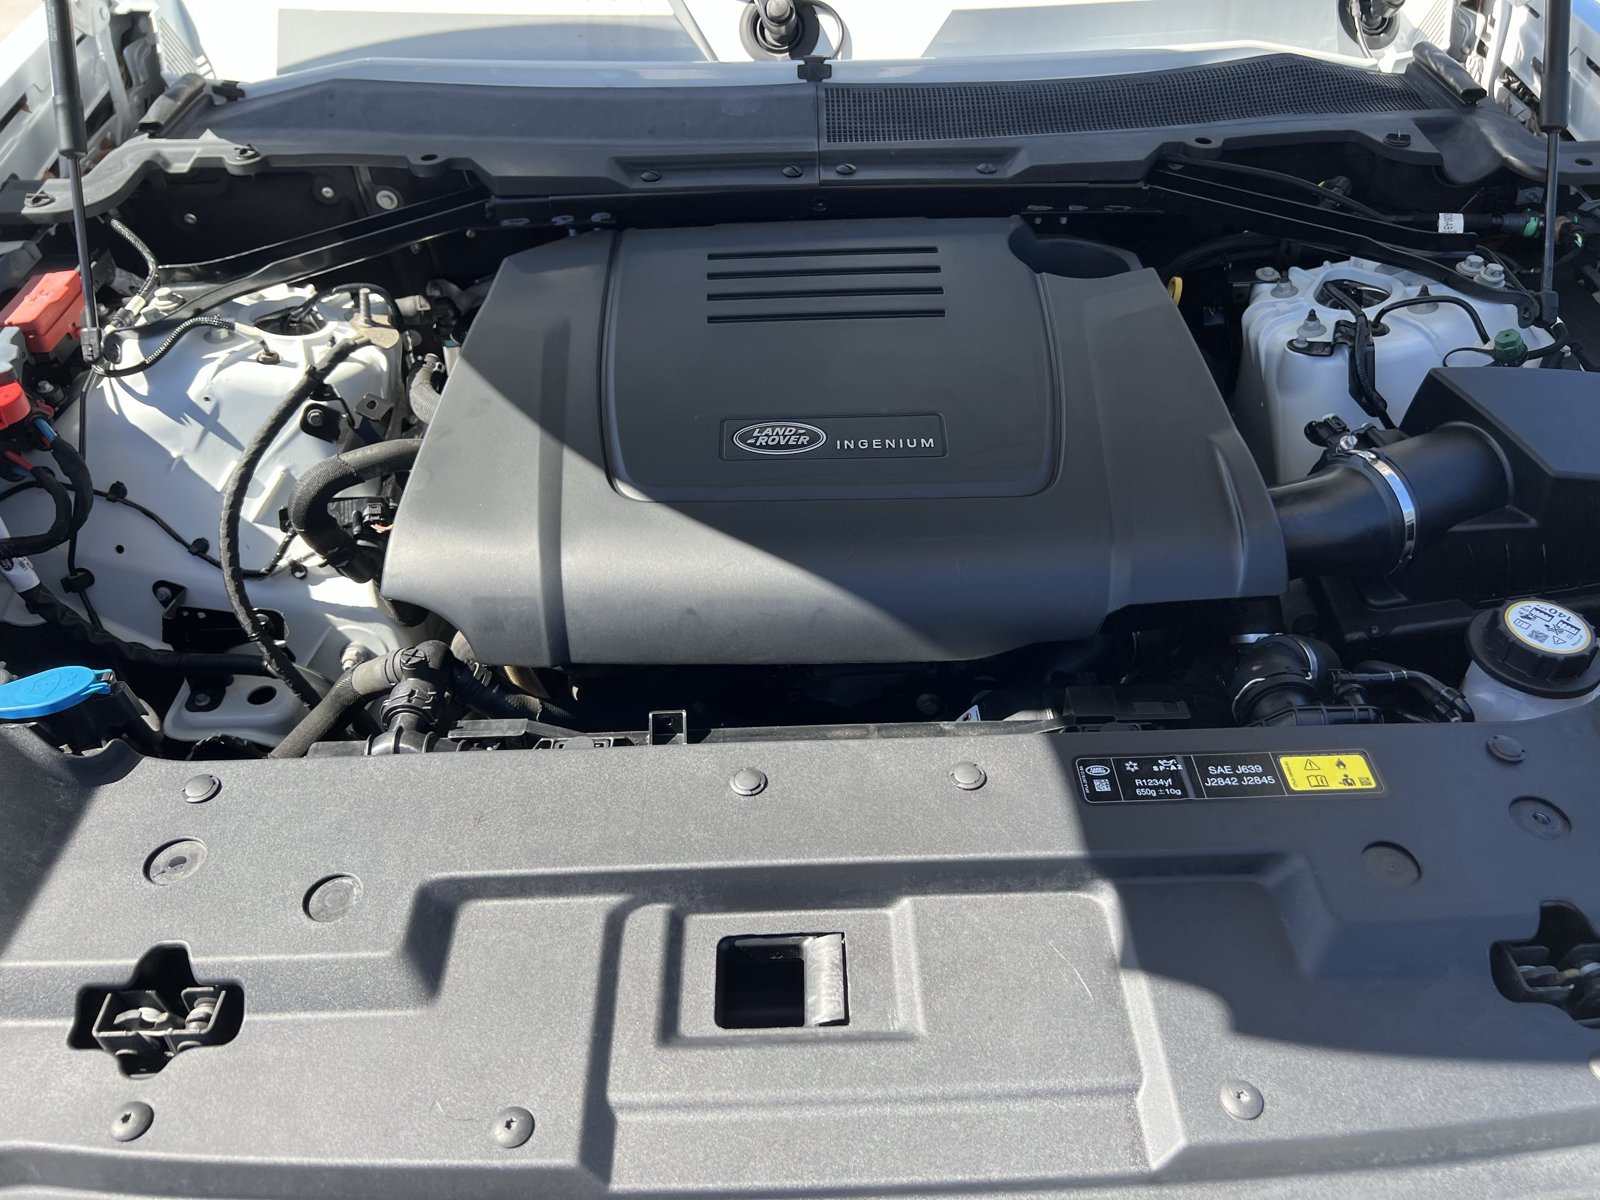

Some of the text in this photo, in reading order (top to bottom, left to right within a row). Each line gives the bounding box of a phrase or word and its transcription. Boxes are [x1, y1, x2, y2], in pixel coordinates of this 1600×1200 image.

[752, 427, 796, 437] LAND
[755, 435, 810, 446] ROVER
[836, 438, 935, 450] INGENIUM
[1548, 608, 1571, 621] 140
[1207, 764, 1263, 775] SAE J639
[1204, 775, 1276, 787] J2842 J2845
[1135, 788, 1157, 797] 650g
